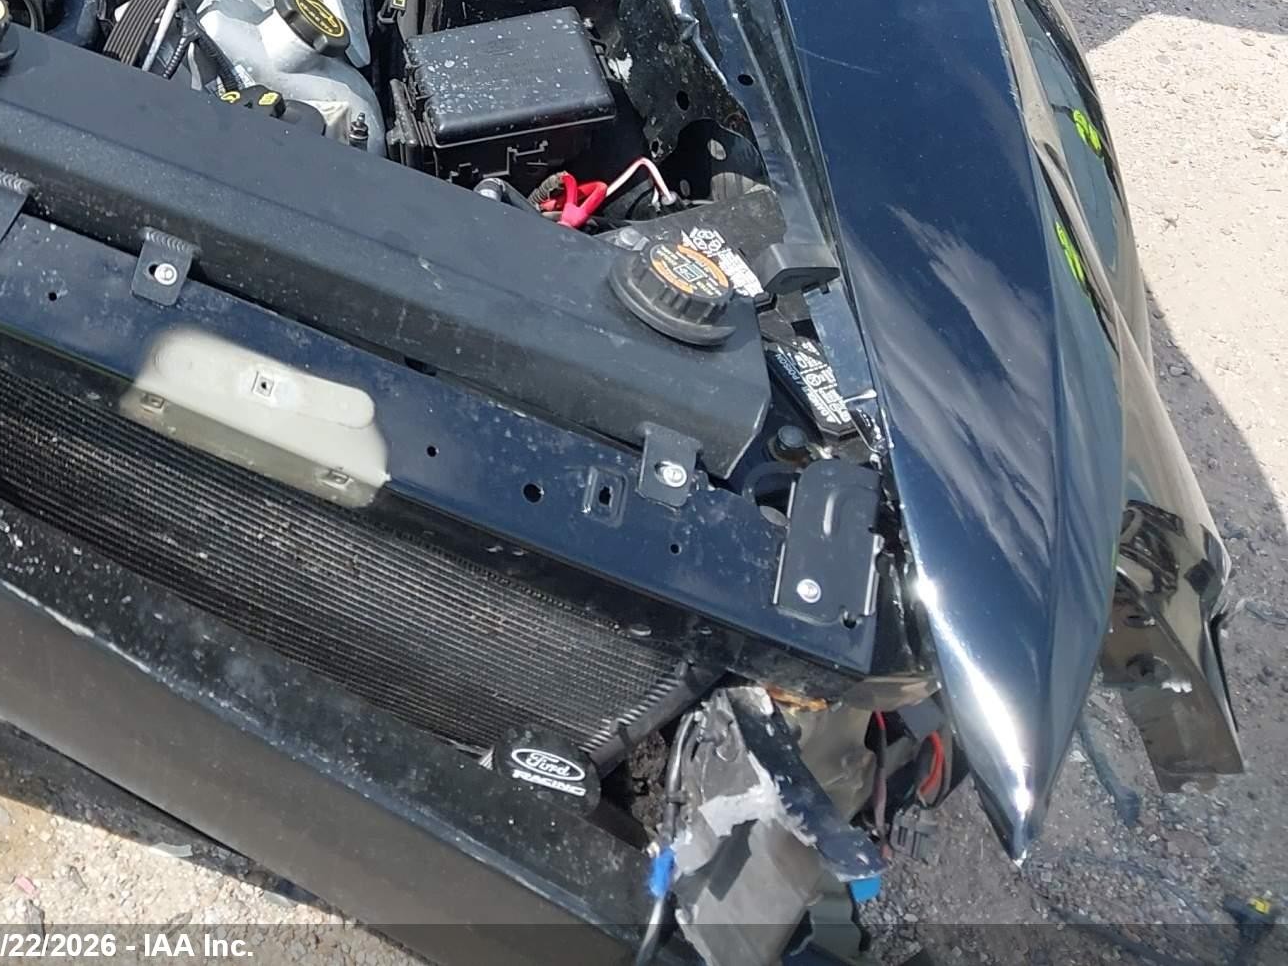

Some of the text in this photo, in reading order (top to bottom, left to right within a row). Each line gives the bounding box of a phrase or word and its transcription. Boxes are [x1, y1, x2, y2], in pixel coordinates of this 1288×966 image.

[775, 353, 801, 381] POISON
[525, 752, 572, 777] Ford
[512, 769, 586, 797] RACING
